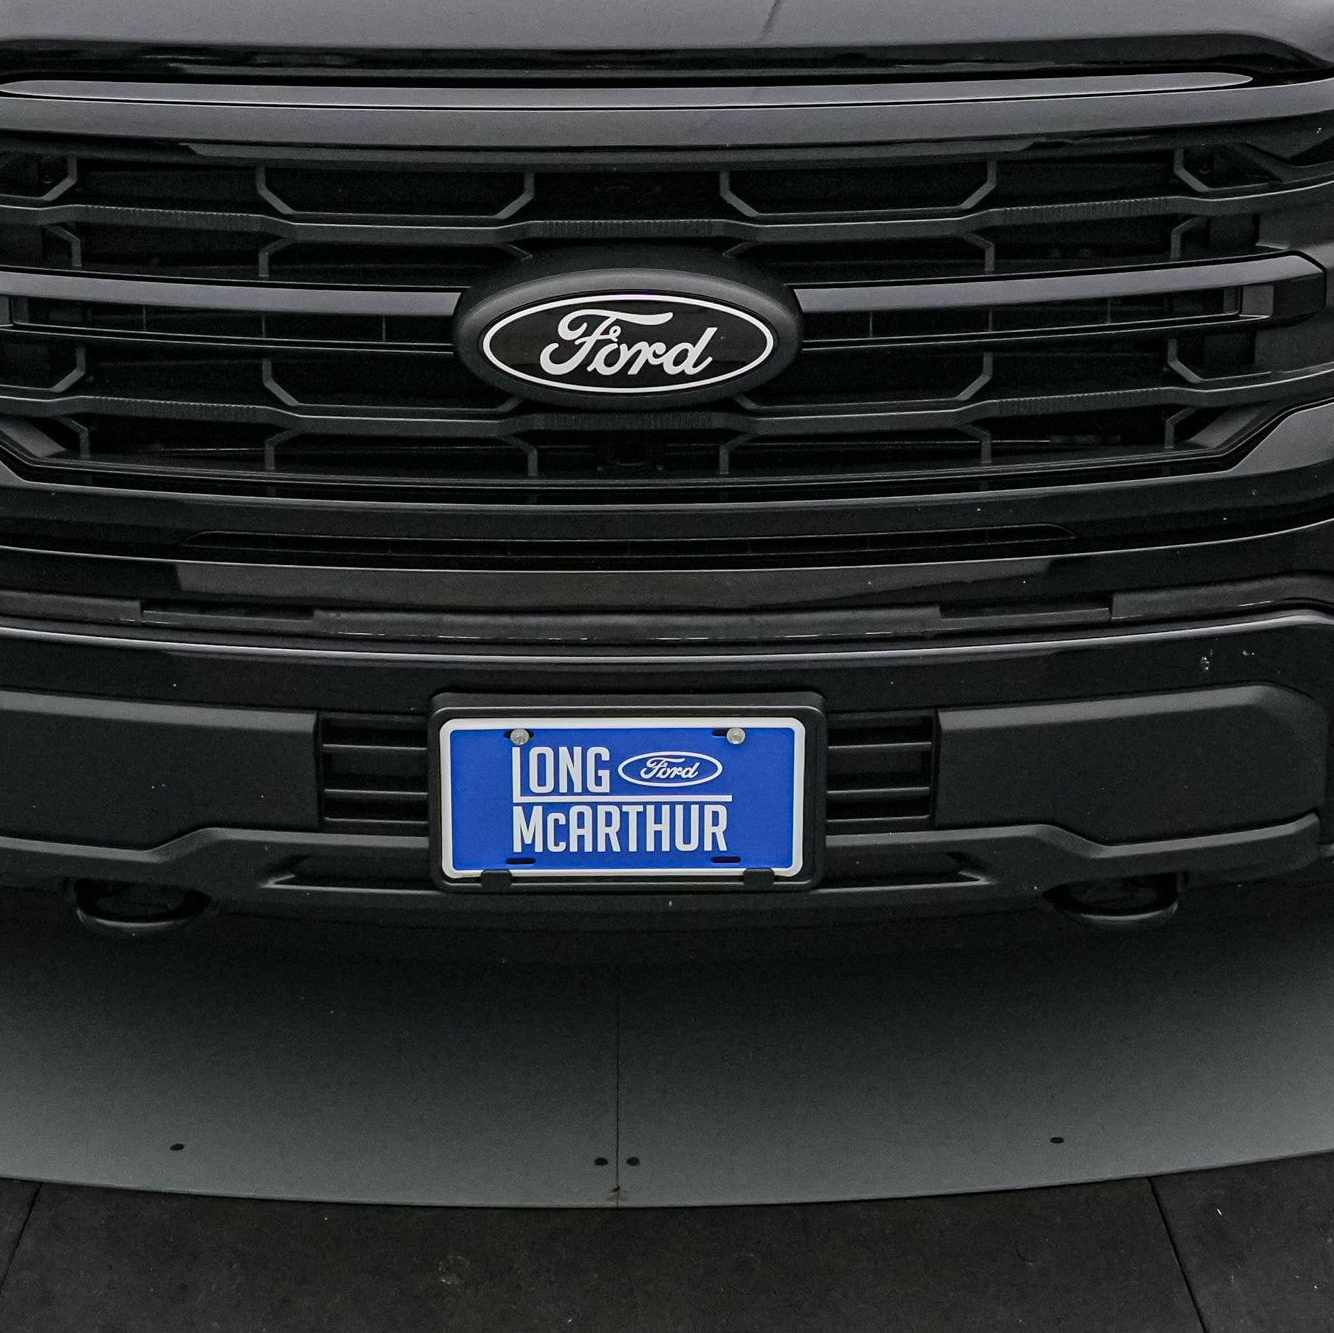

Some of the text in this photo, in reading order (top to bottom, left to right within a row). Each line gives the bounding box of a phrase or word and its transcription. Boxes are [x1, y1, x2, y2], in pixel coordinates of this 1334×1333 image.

[539, 308, 718, 376] Ford
[512, 746, 701, 803] LONG Ford
[512, 804, 729, 853] McARTHUR
